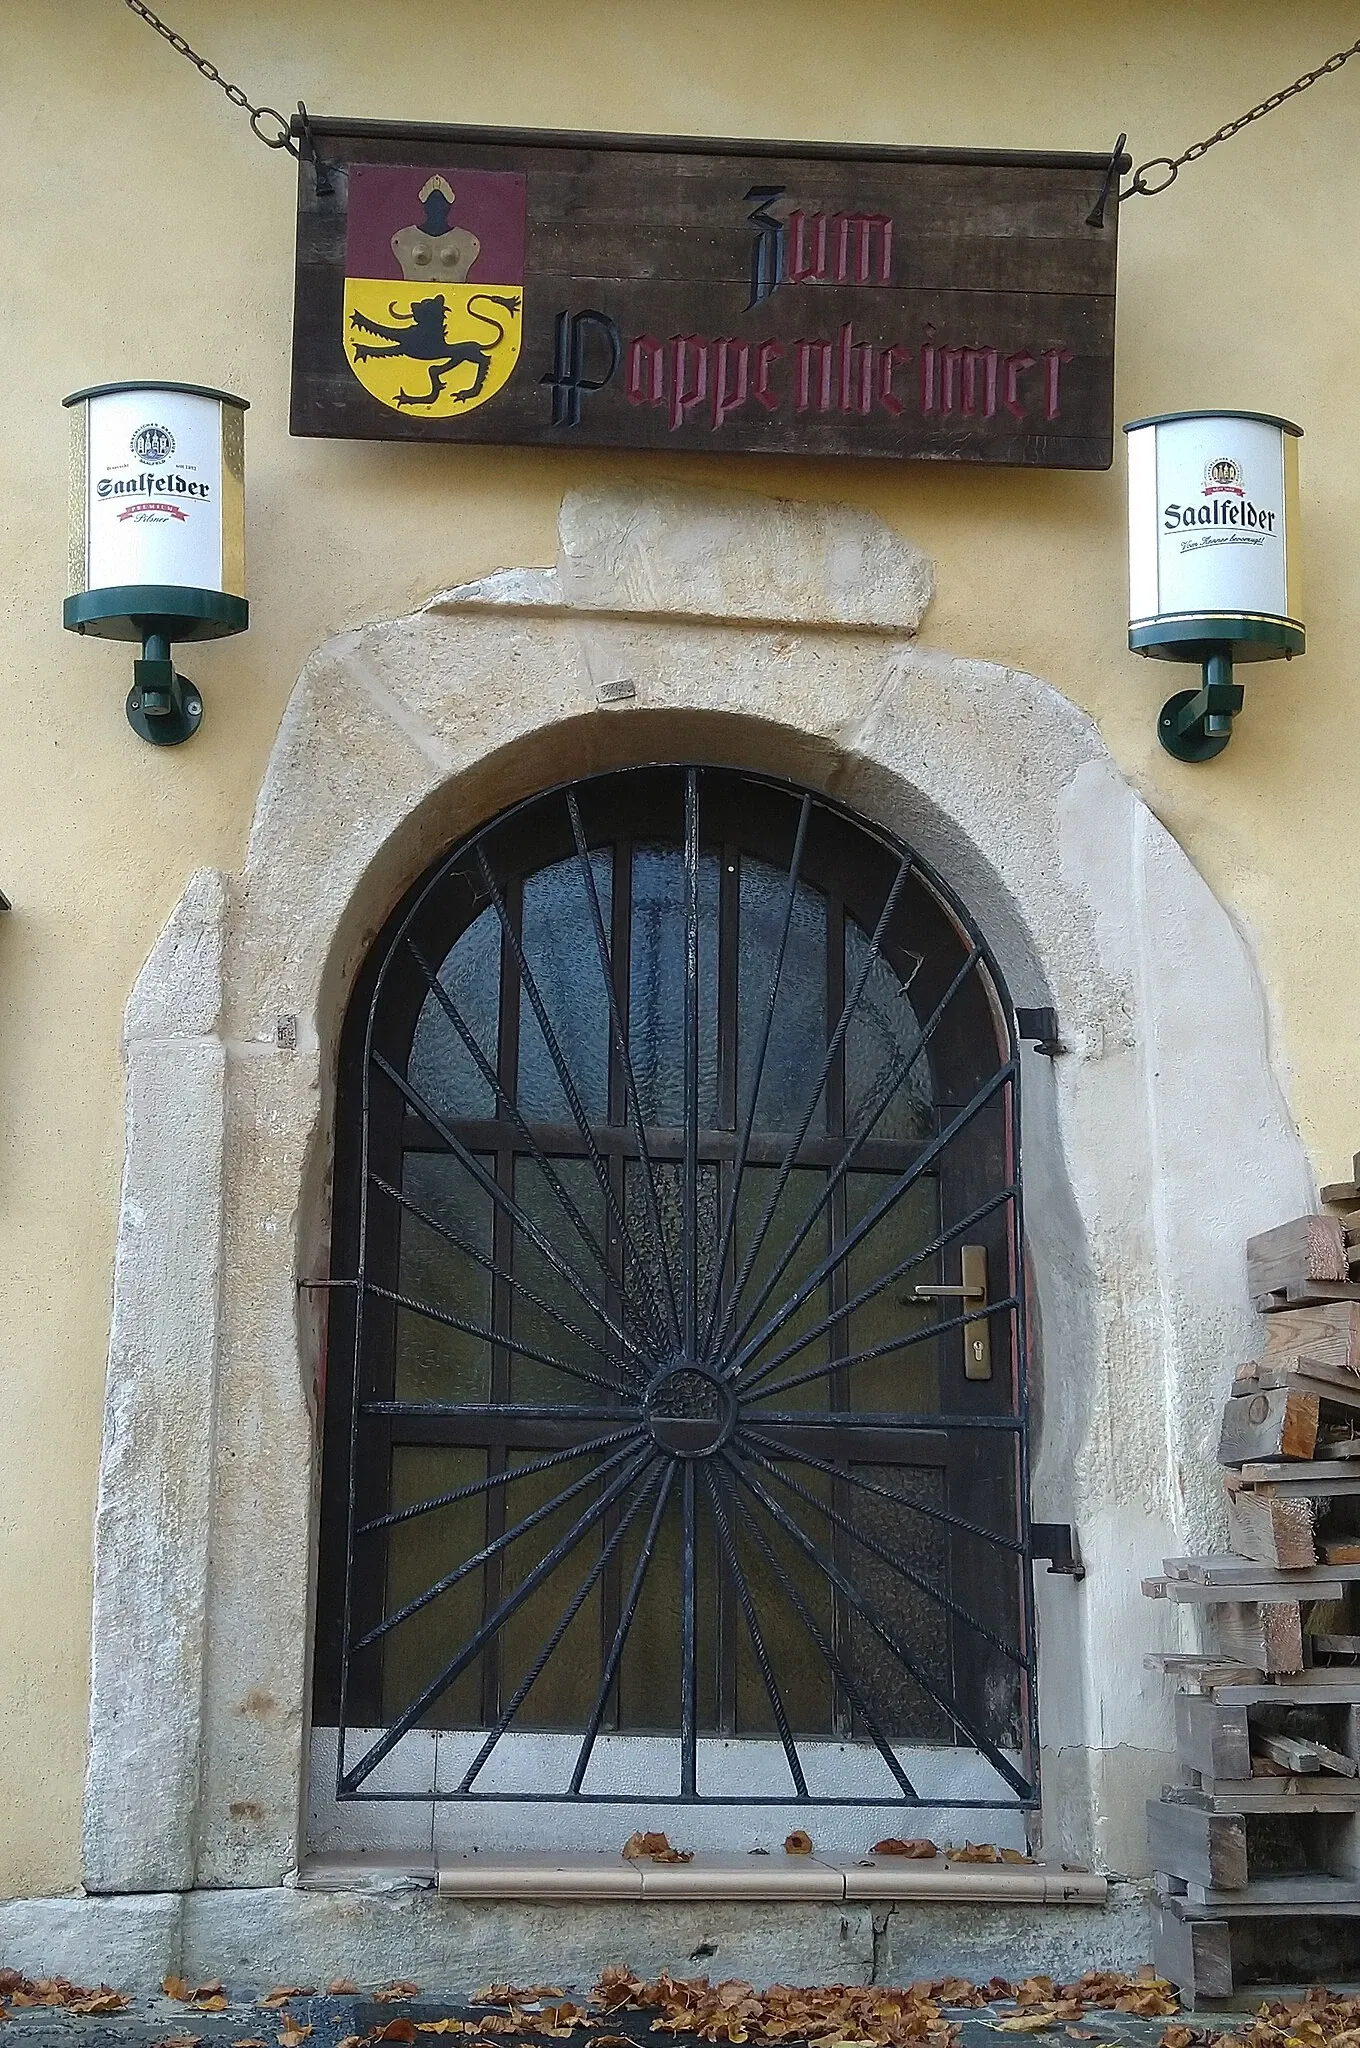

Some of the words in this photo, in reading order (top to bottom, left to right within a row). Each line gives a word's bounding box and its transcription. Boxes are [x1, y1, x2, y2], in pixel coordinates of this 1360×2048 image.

[741, 185, 893, 312] Zum
[539, 309, 1074, 432] Pappenheimer
[97, 473, 210, 498] Saalfelder
[133, 513, 170, 523] Pilsner
[1164, 499, 1276, 532] Saalfelder
